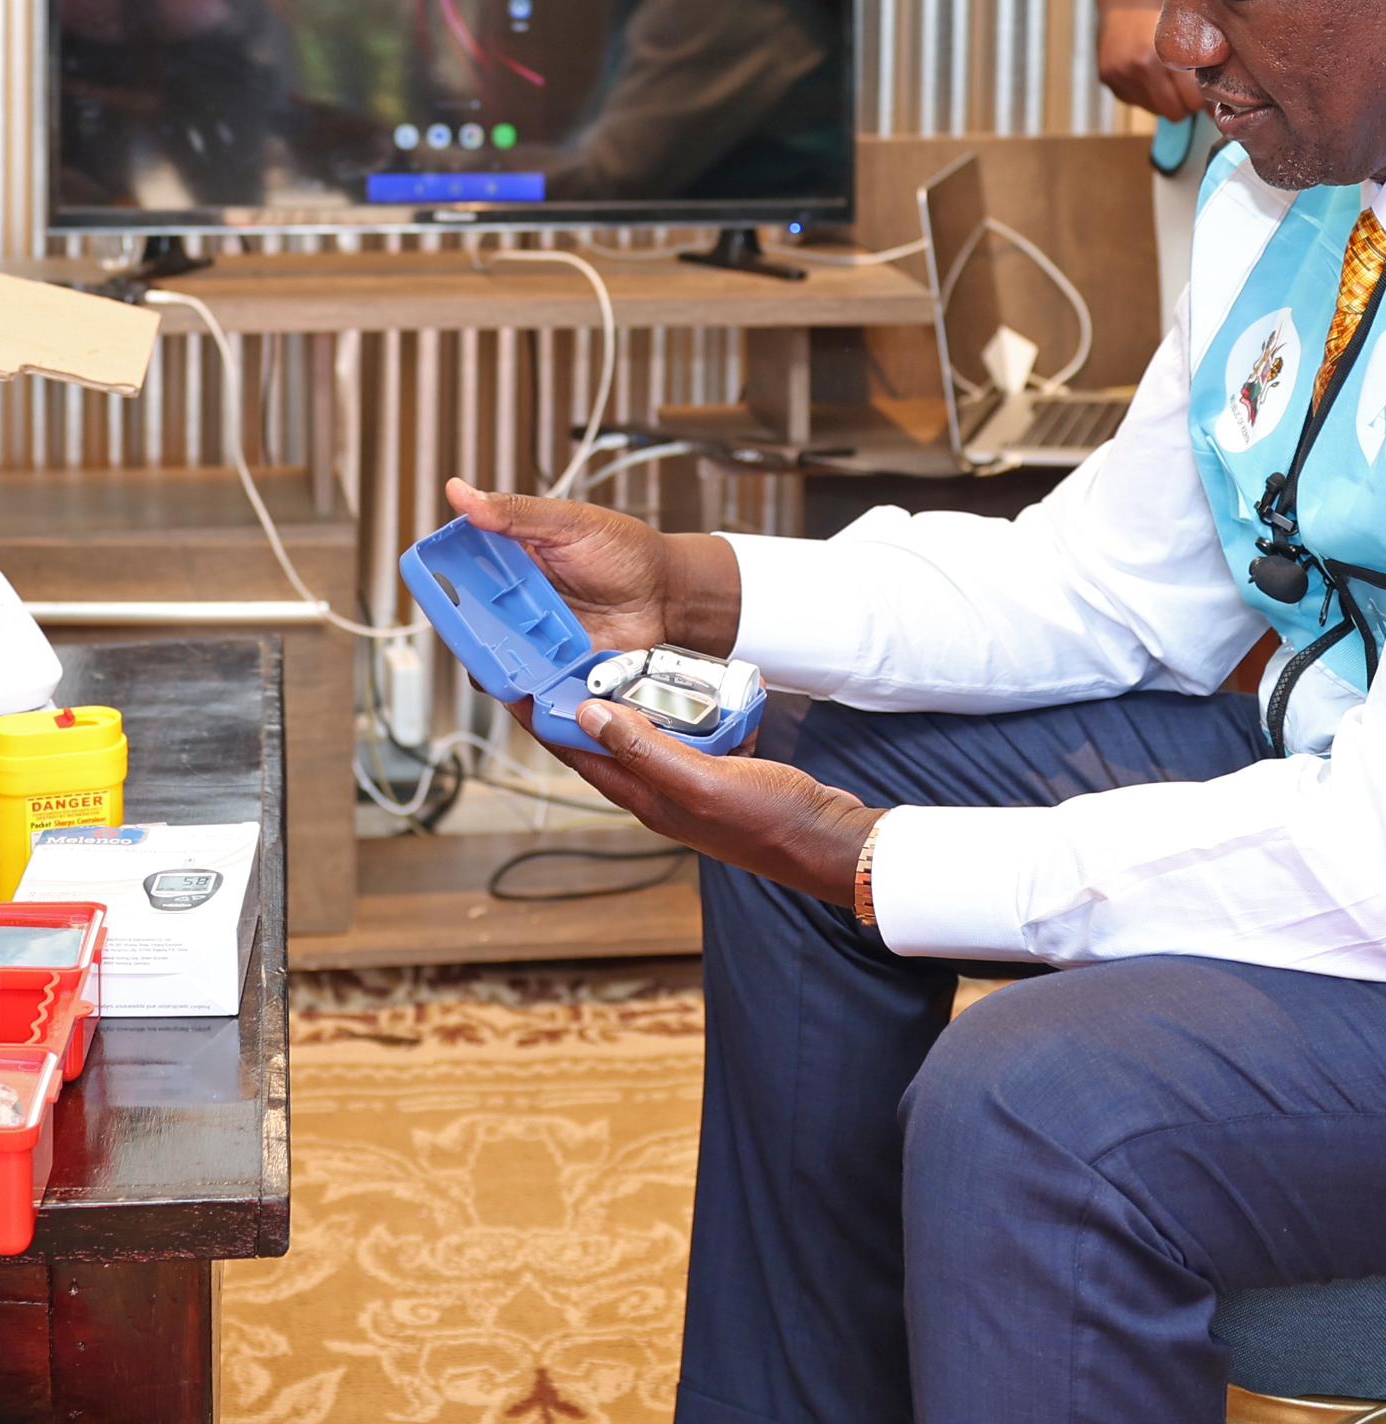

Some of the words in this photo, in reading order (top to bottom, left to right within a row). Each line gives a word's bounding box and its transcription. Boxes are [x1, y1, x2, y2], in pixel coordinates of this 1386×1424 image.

[31, 796, 103, 812] DANGER
[30, 821, 51, 829] Pocket
[46, 837, 132, 845] Melenco
